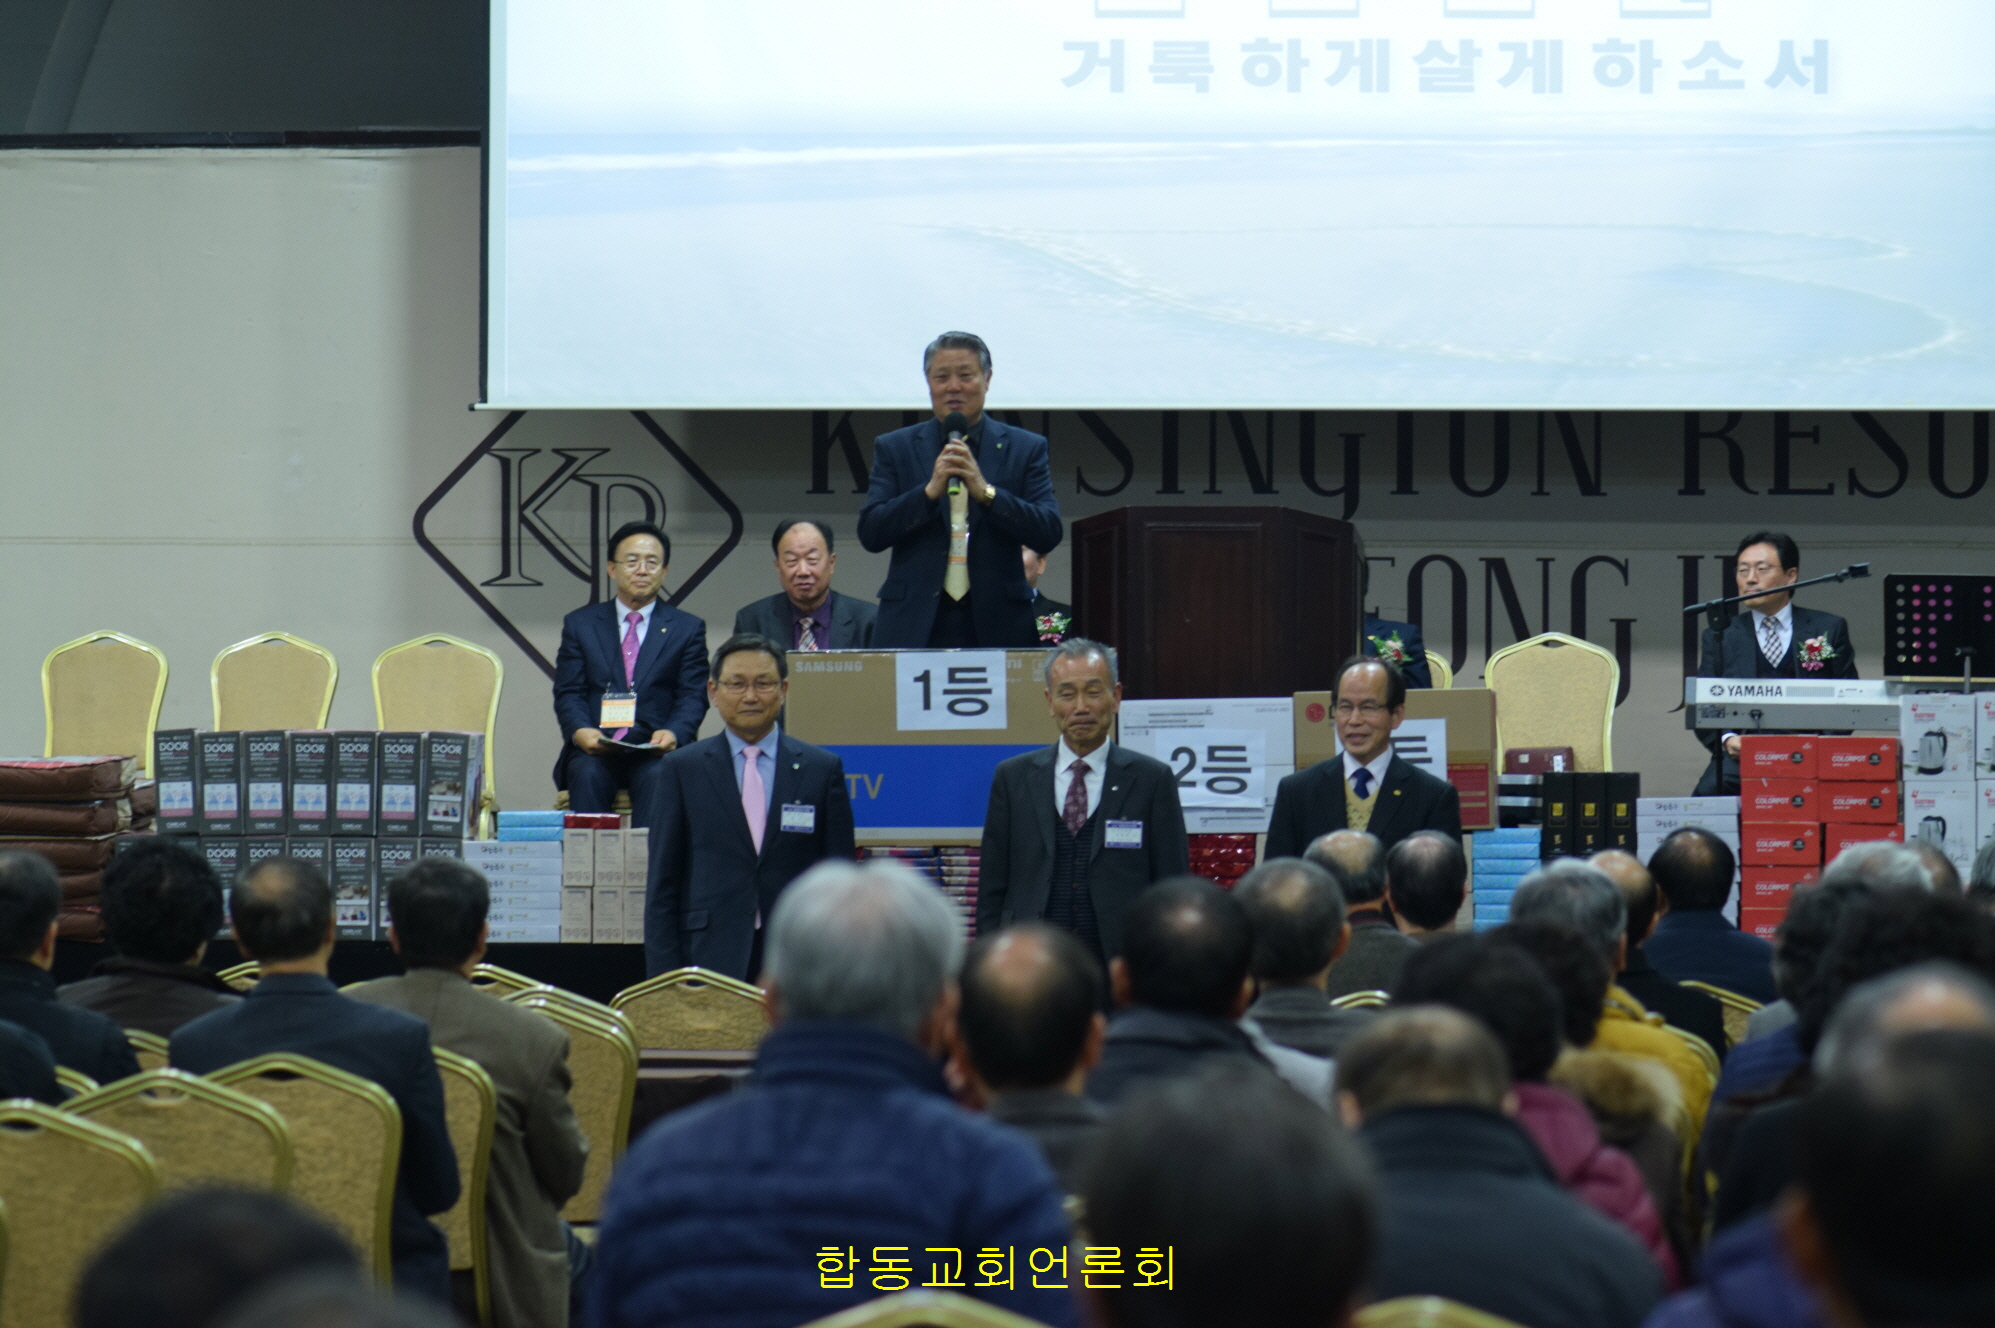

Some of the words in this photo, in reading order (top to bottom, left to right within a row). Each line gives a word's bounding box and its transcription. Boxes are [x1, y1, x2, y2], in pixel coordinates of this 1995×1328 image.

[794, 660, 863, 673] SAMSUNG
[913, 666, 993, 717] 1등
[1727, 685, 1783, 698] YAMAHA
[159, 741, 189, 751] DOOR
[204, 743, 234, 753] DOOR
[250, 742, 280, 752] DOOR
[295, 743, 326, 753] DOOR
[339, 743, 369, 753] DOOR
[384, 744, 415, 754] DOOR
[432, 744, 462, 754] DOOR
[1170, 745, 1252, 795] 2등
[206, 848, 238, 858] DOOR
[336, 848, 366, 858] DOOR
[381, 850, 412, 860] DOOR
